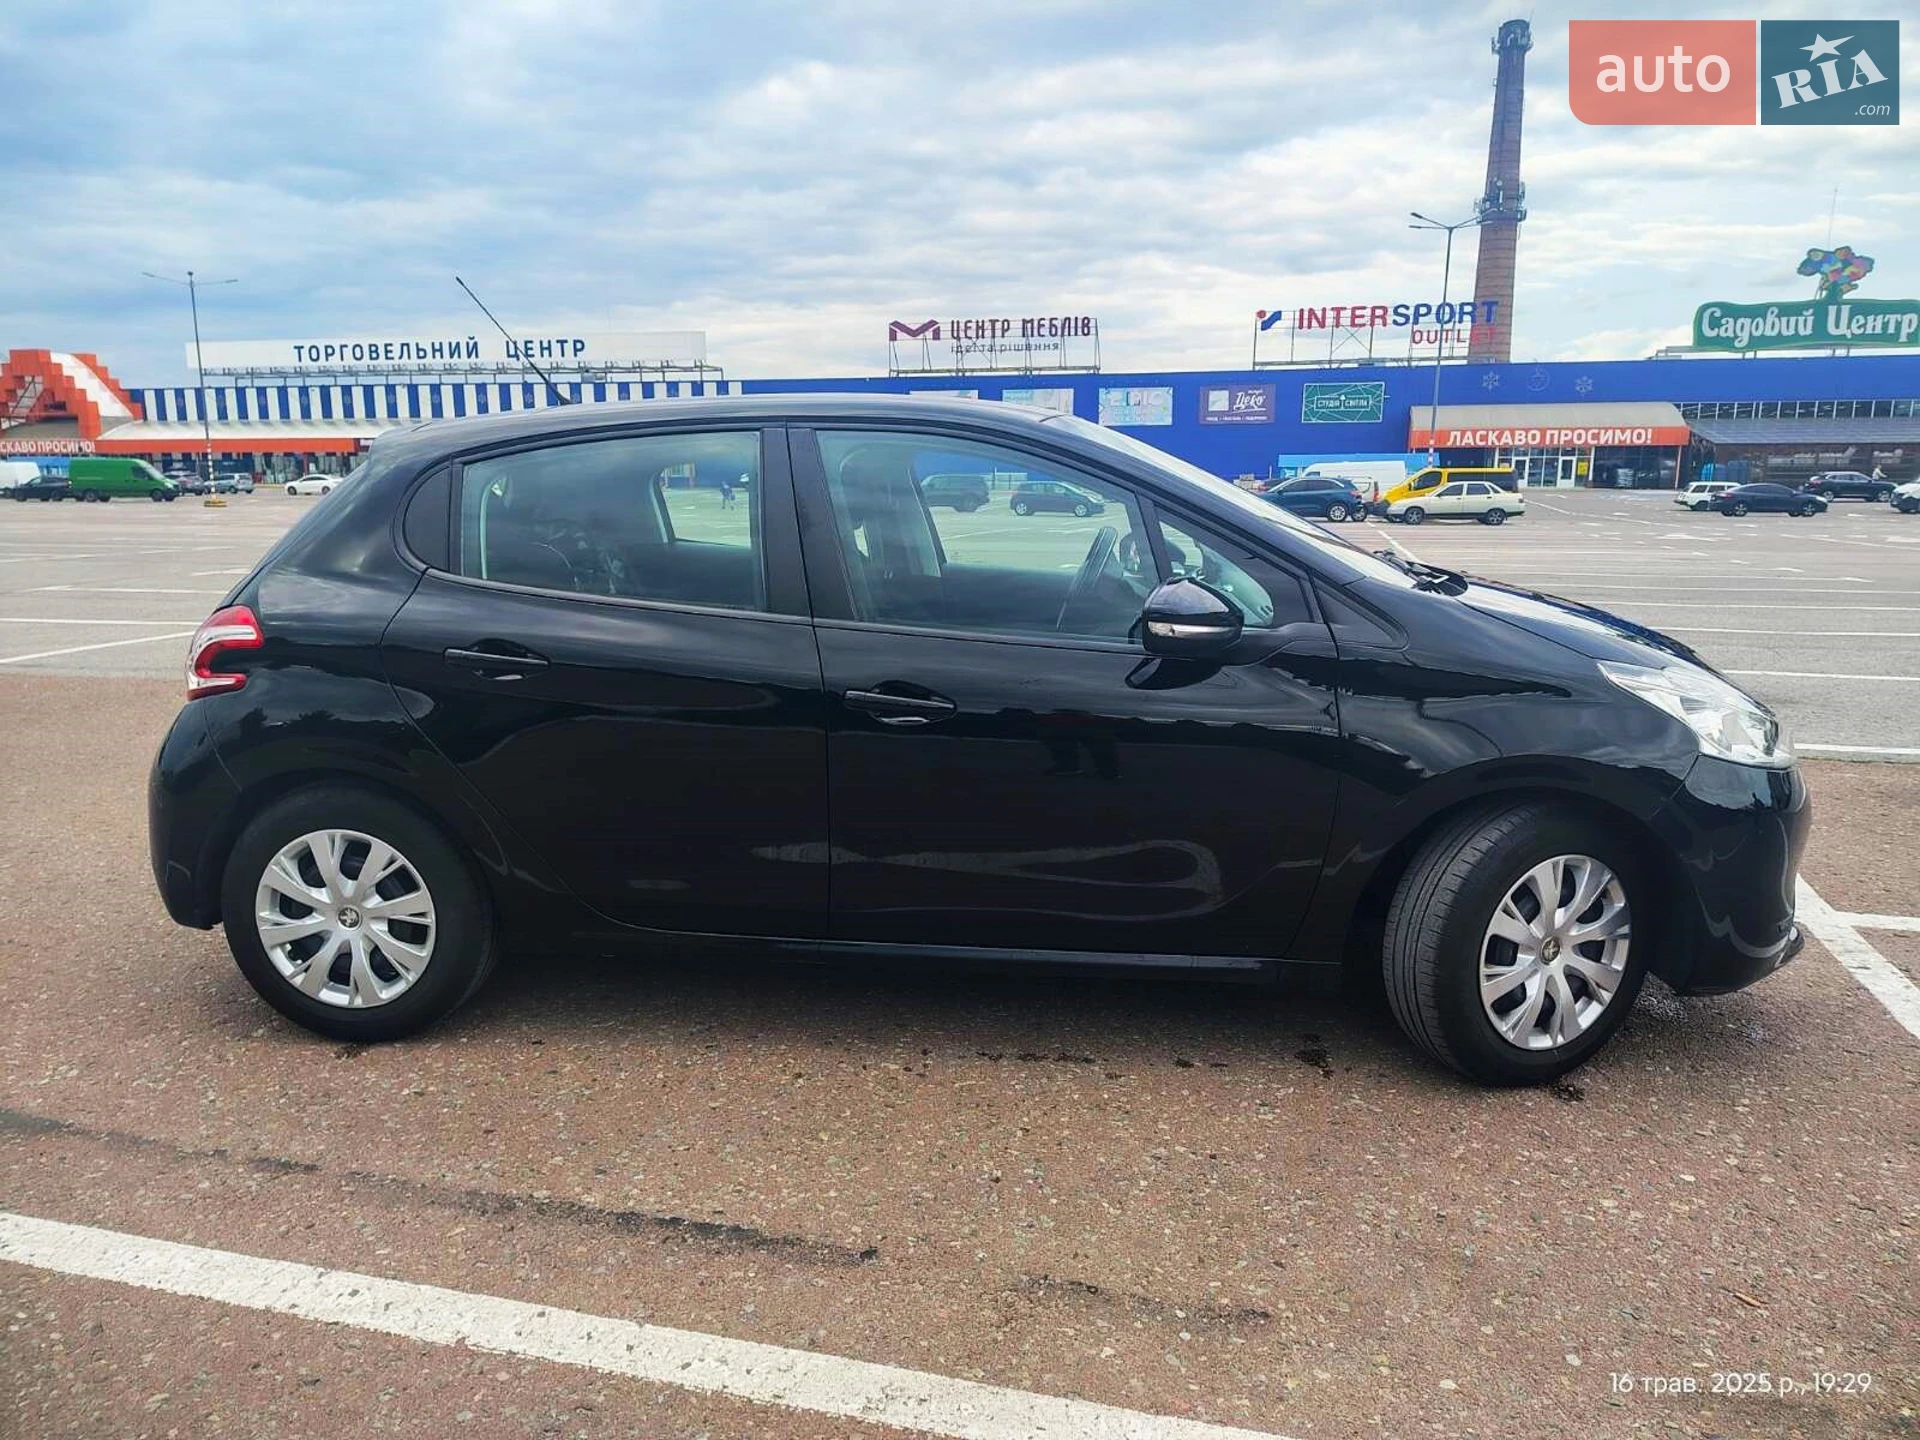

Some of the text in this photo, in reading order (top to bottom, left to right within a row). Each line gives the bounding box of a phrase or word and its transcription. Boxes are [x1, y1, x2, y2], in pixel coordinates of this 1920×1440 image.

[1297, 300, 1499, 330] INTERSPORT
[1701, 304, 1919, 348] Садовий Центр
[950, 316, 1092, 341] ЦЕНТР МЕБЛІВ
[1411, 327, 1497, 344] OUTLET
[293, 336, 587, 362] ТОРГОВЕЛЬНИЙ ЦЕНТР
[1447, 428, 1652, 446] ЛАСКАВО ПРОСИМО!
